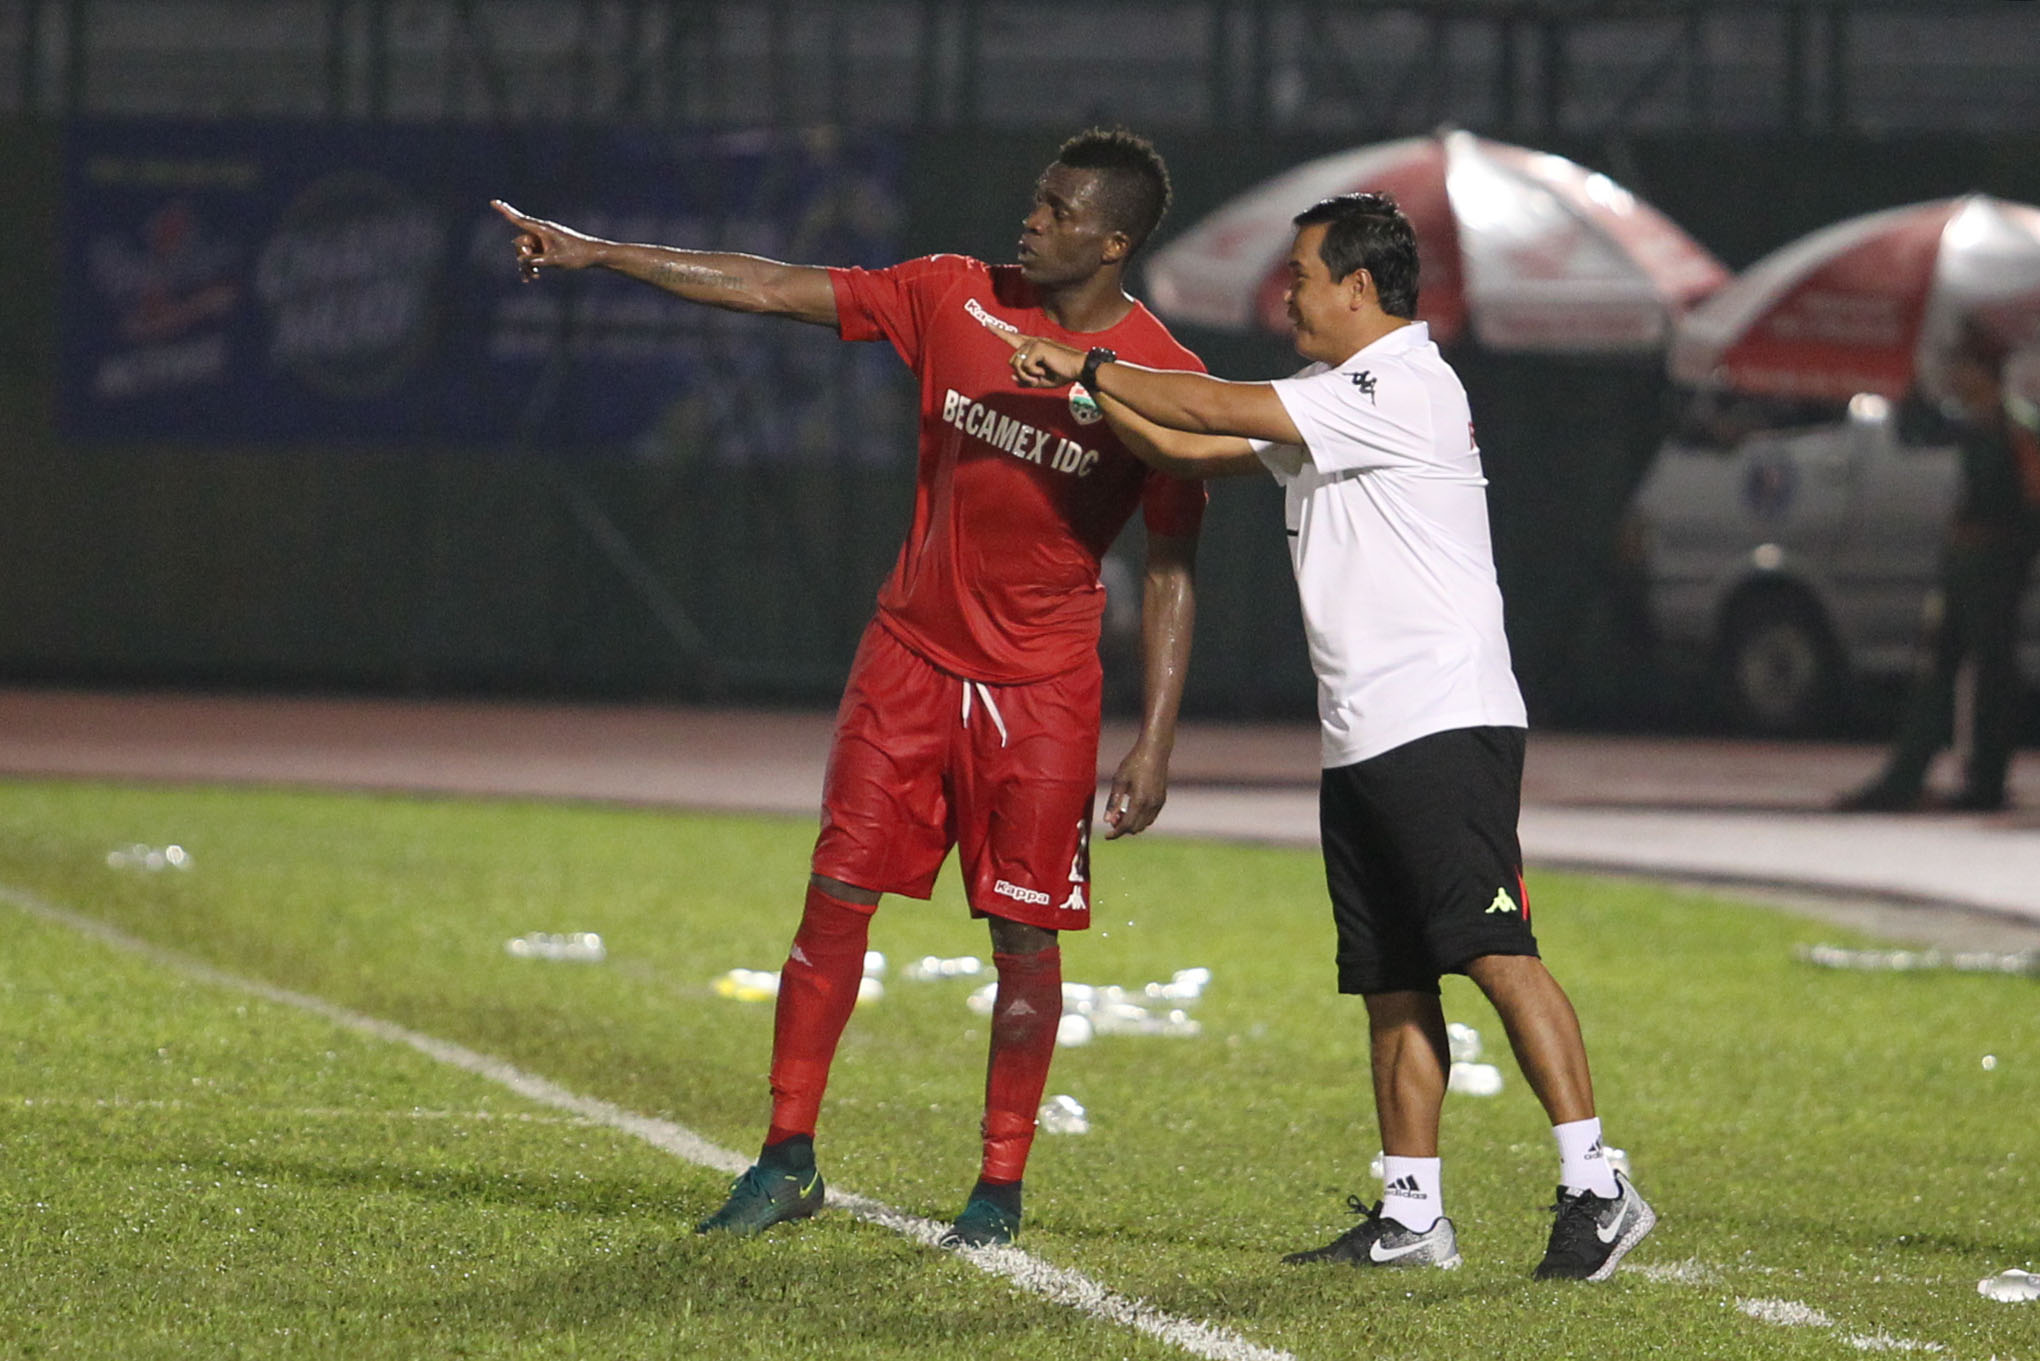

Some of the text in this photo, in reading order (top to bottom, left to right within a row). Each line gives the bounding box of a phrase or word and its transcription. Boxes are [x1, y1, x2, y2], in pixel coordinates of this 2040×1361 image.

[942, 388, 1099, 477] BECAMEX IDC
[994, 880, 1050, 904] Kappa
